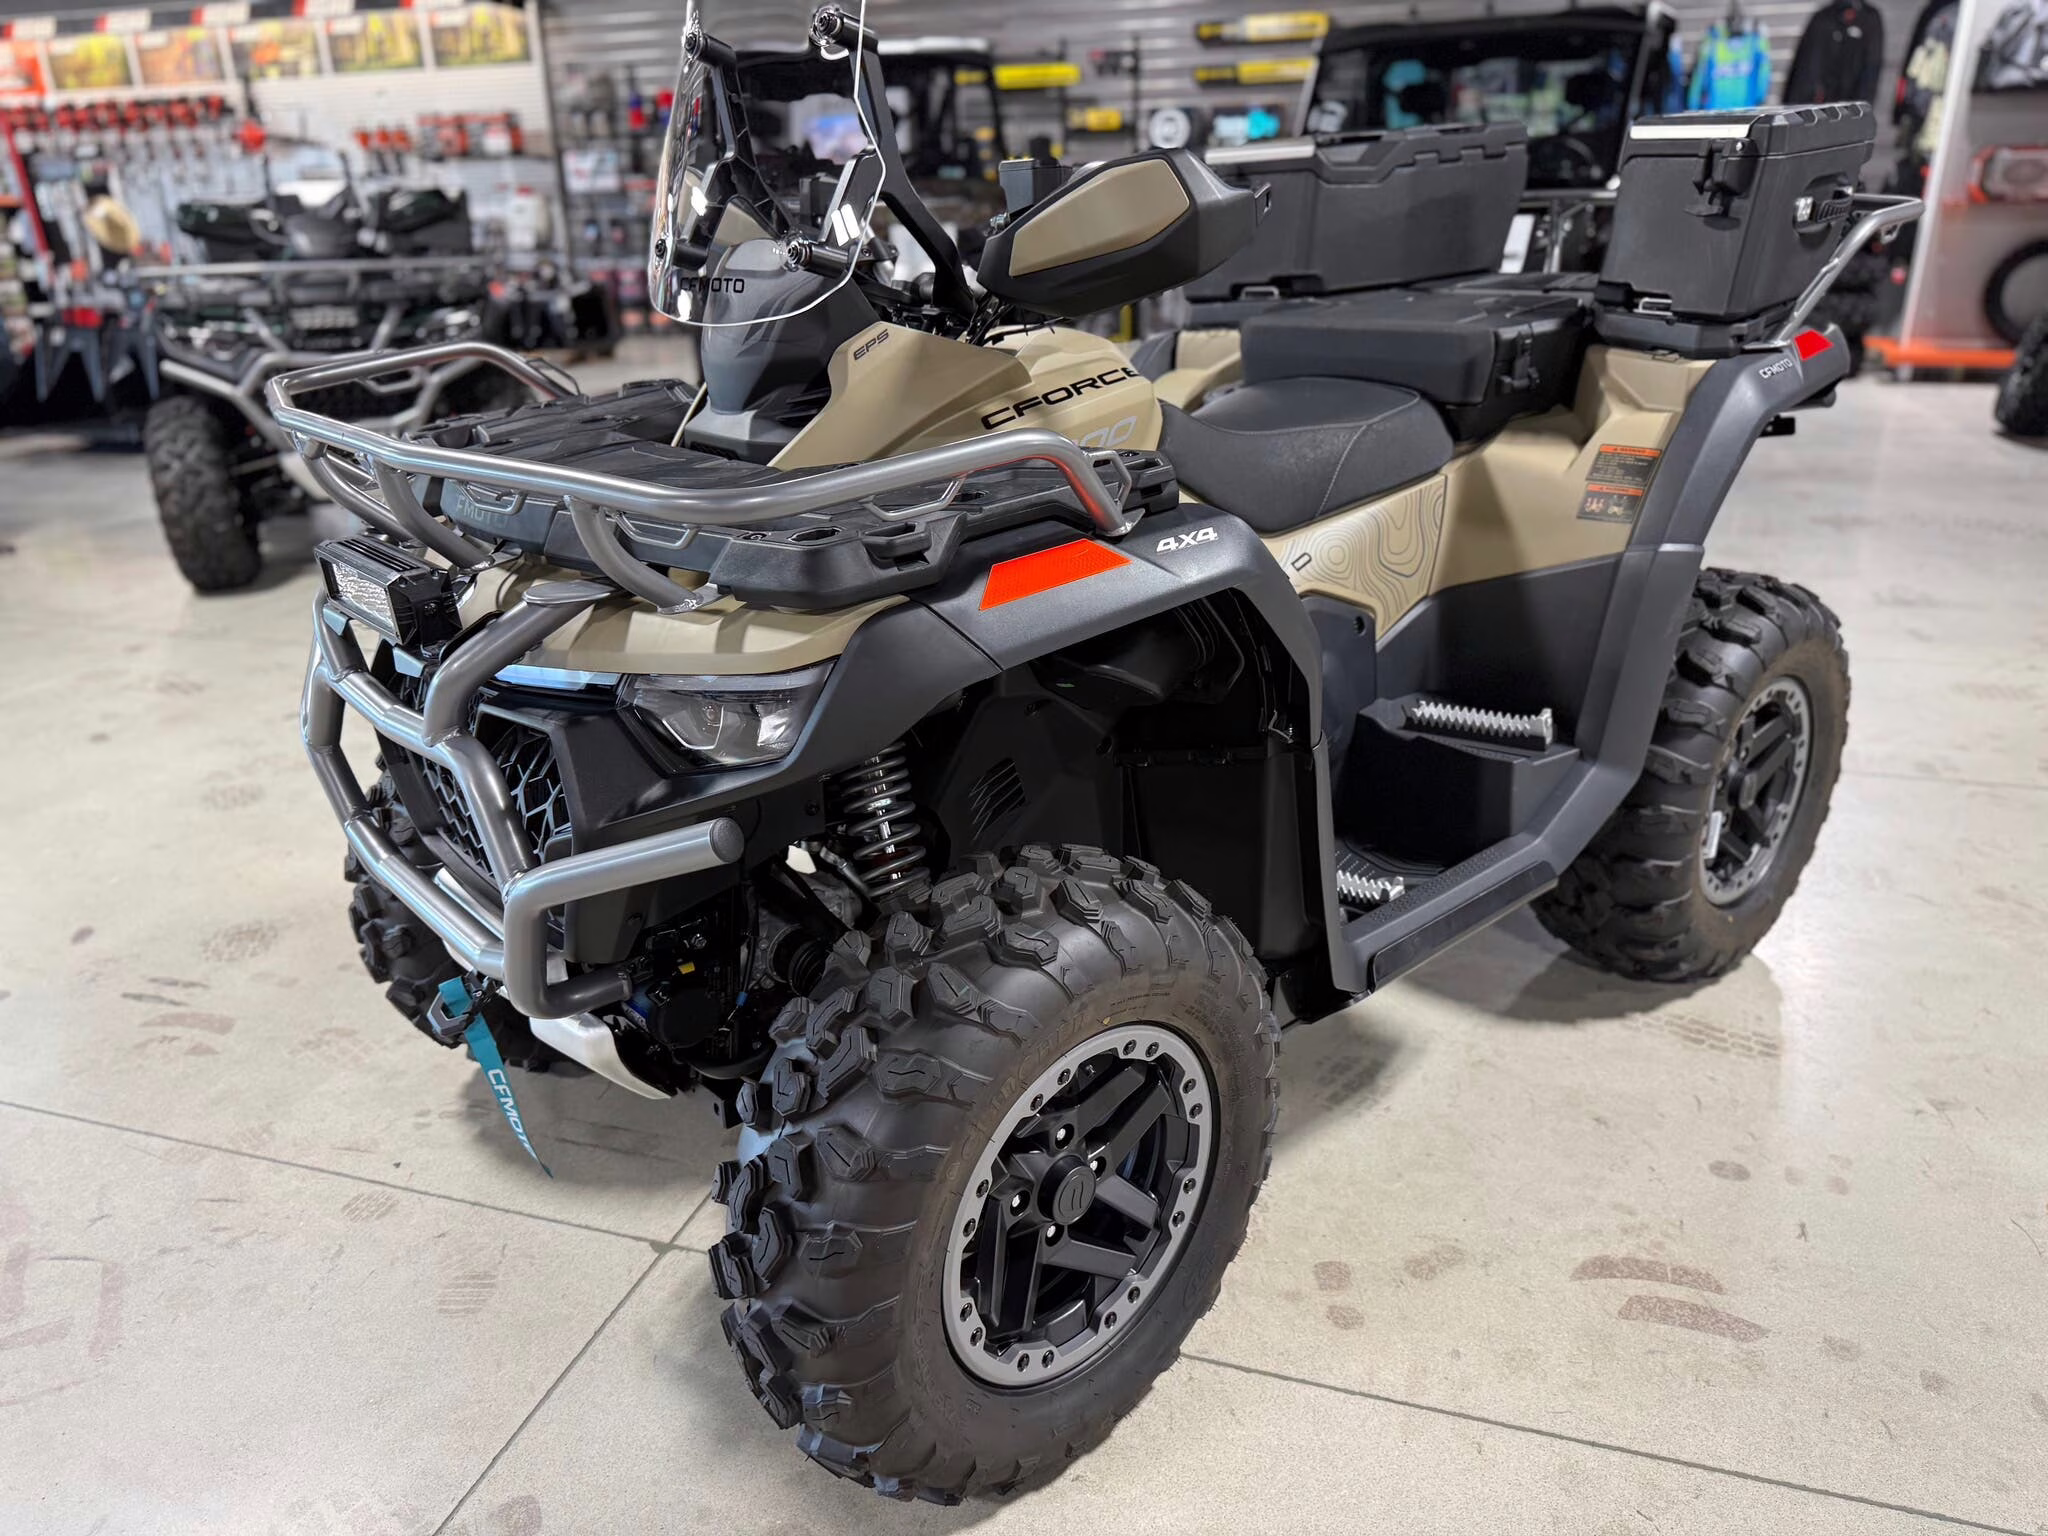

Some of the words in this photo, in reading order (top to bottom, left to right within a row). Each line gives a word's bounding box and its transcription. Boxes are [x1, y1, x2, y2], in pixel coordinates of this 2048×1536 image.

[681, 277, 745, 293] CFMOTO
[853, 328, 889, 361] EPS
[1759, 358, 1793, 379] CFMOTO
